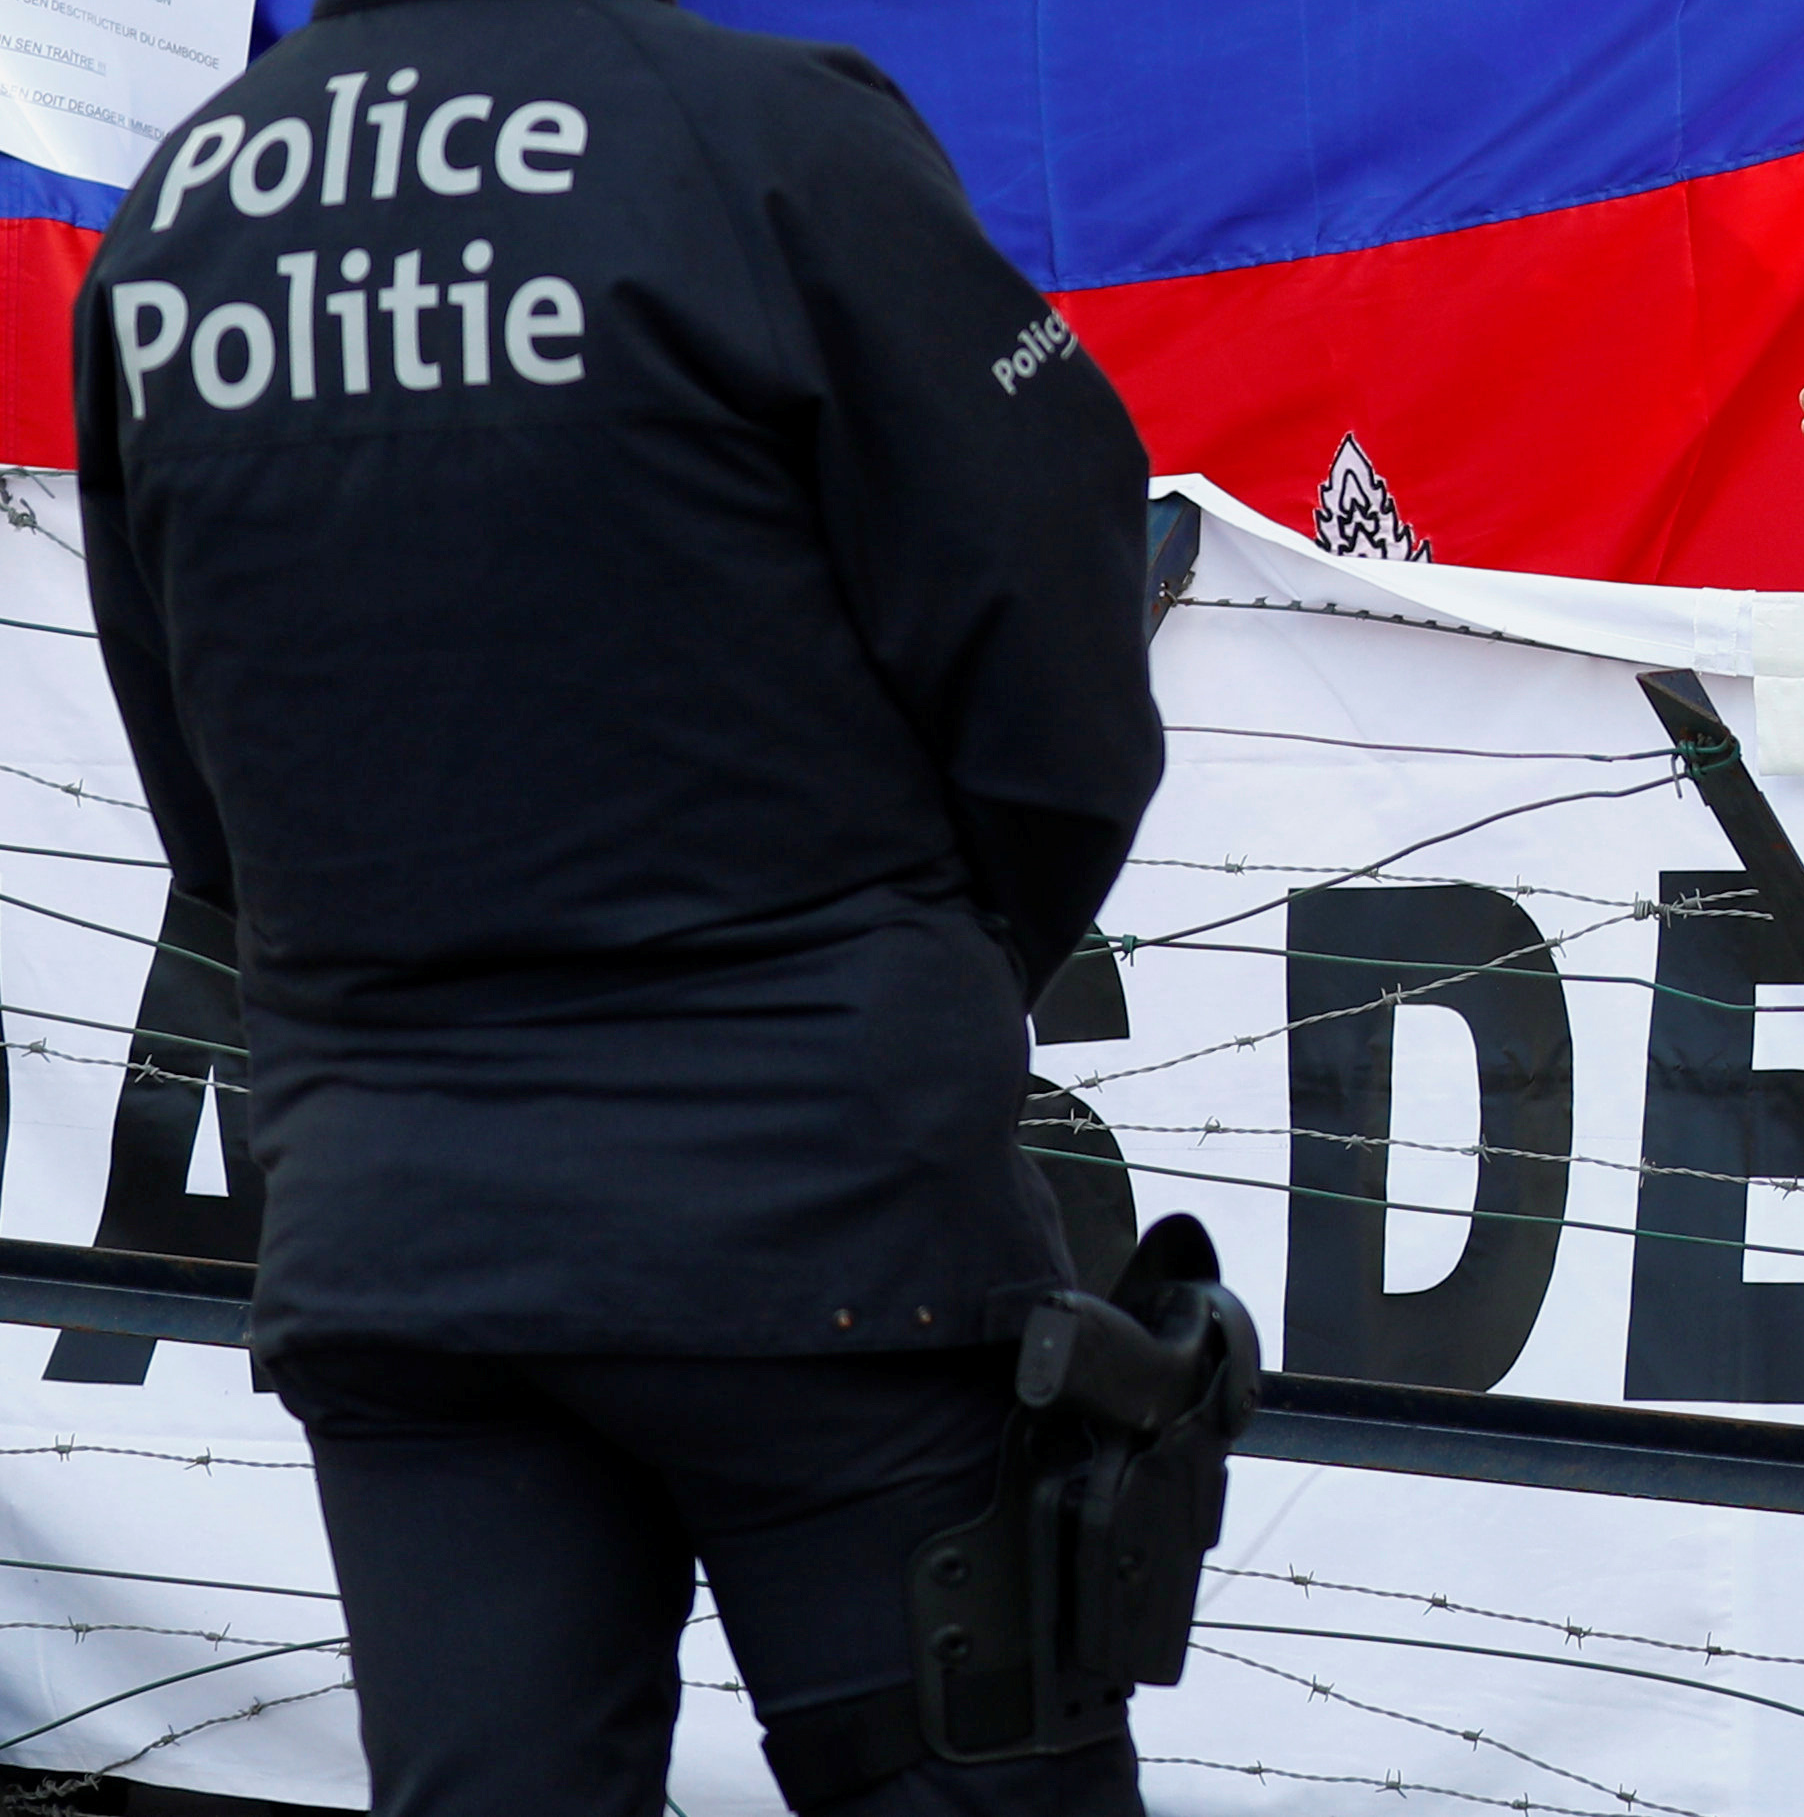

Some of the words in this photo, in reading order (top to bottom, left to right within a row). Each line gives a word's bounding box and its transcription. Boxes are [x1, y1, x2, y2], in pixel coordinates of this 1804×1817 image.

[15, 37, 42, 55] SEN
[140, 30, 155, 48] DU
[157, 38, 220, 70] CAMBODGE
[32, 90, 66, 109] DOIT
[68, 98, 126, 127] DEGAGER
[151, 67, 588, 232] Police
[112, 239, 585, 420] Politie
